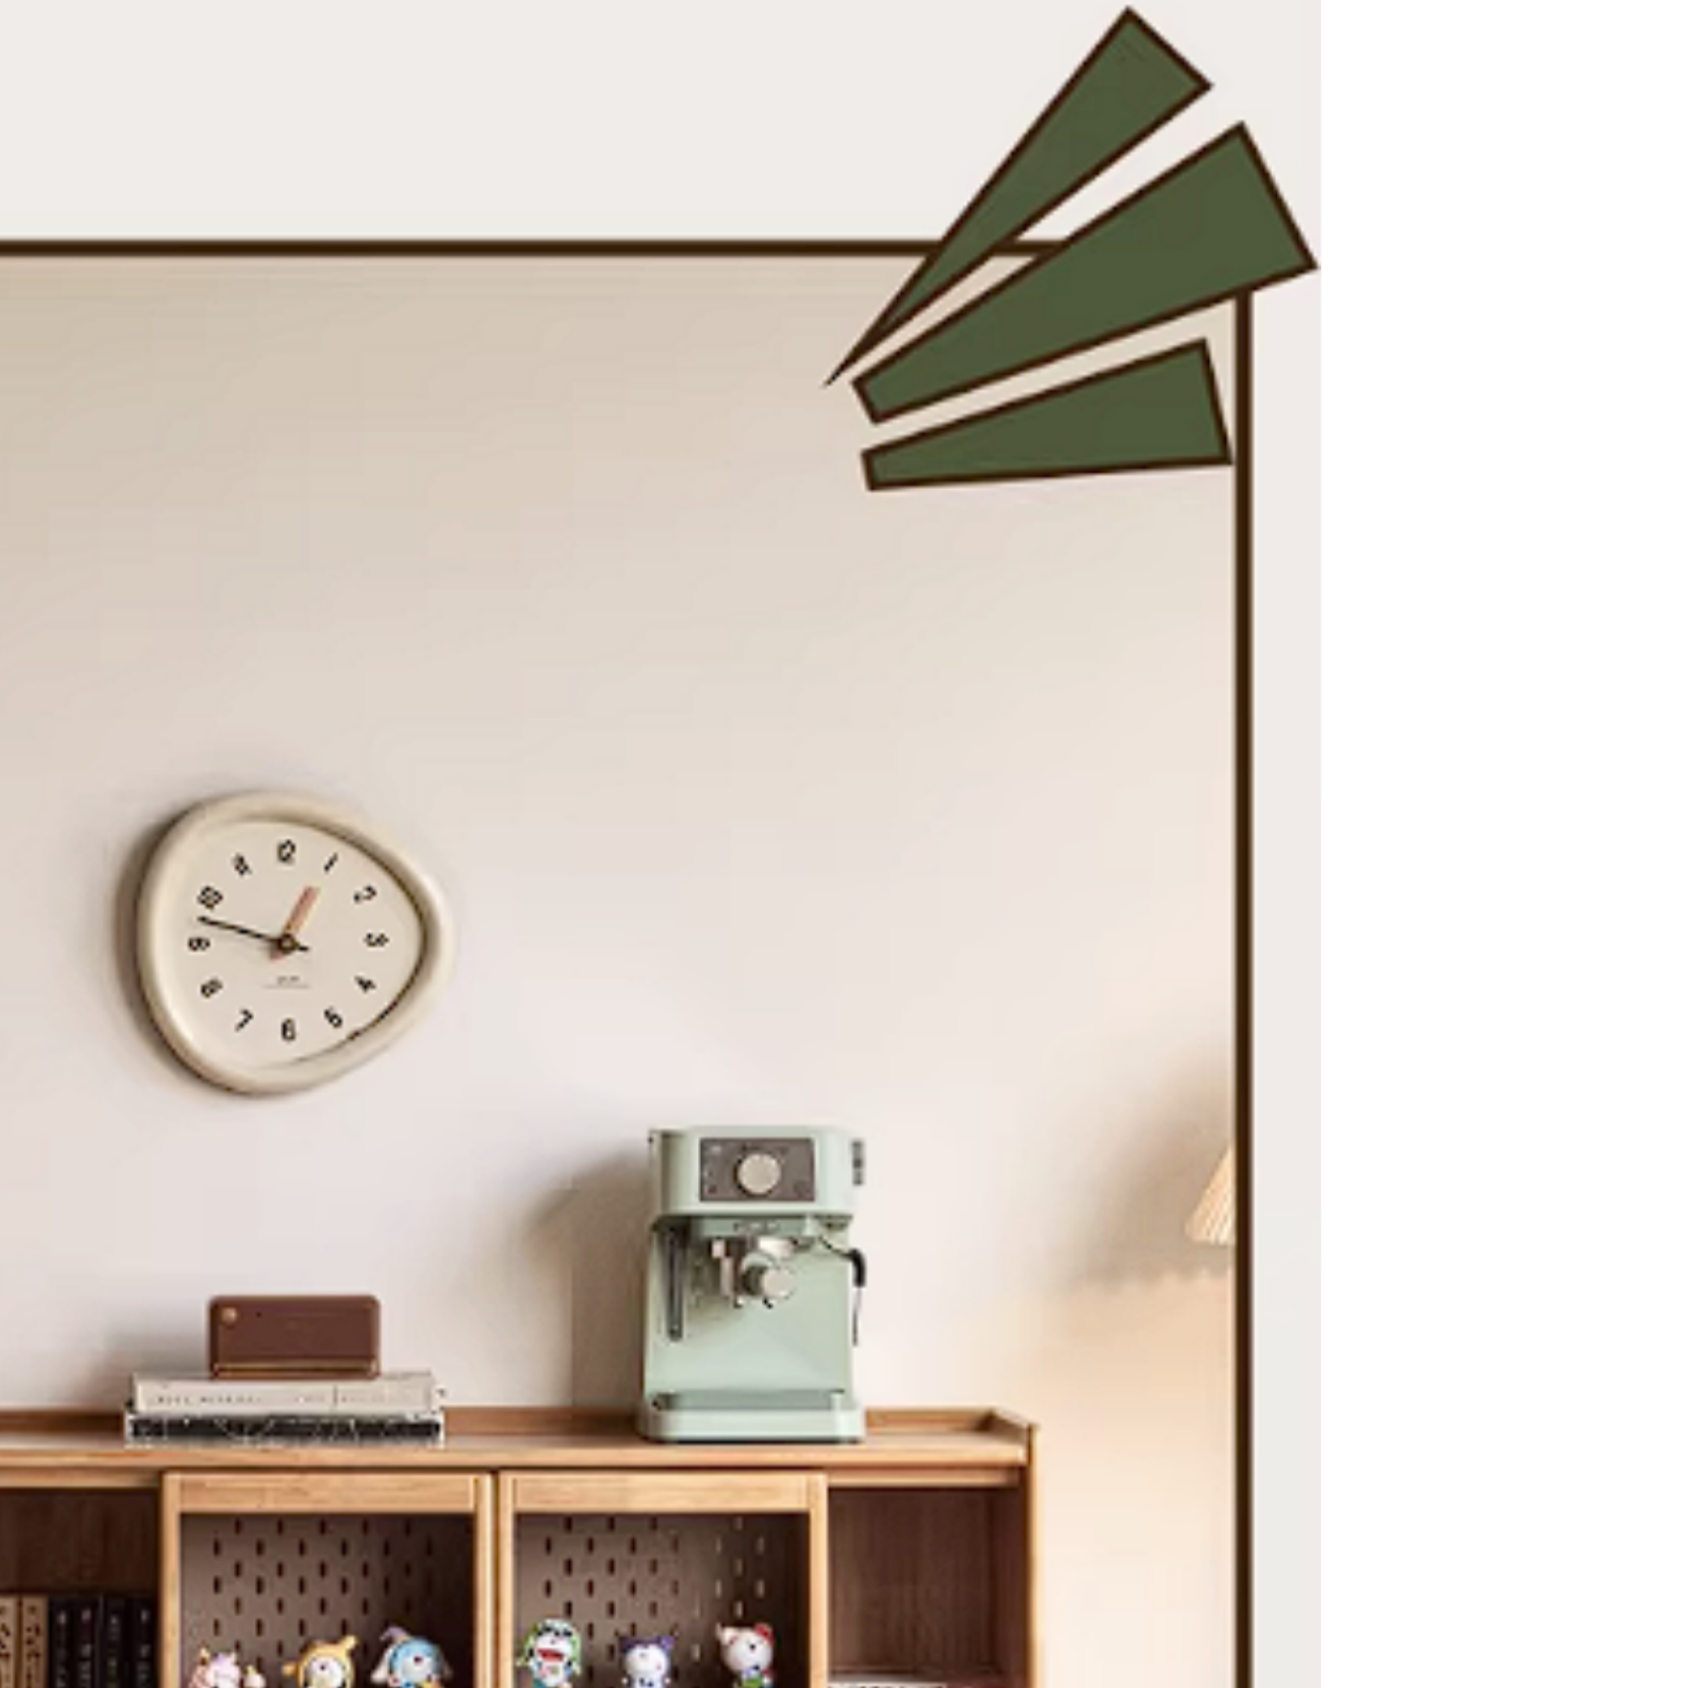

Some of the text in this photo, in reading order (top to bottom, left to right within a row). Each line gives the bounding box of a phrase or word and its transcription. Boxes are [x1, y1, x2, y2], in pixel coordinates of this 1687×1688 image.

[353, 885, 377, 904] 2
[354, 975, 376, 993] 4
[235, 1008, 253, 1031] 7
[324, 1006, 343, 1028] 5
[281, 1018, 296, 1041] 6
